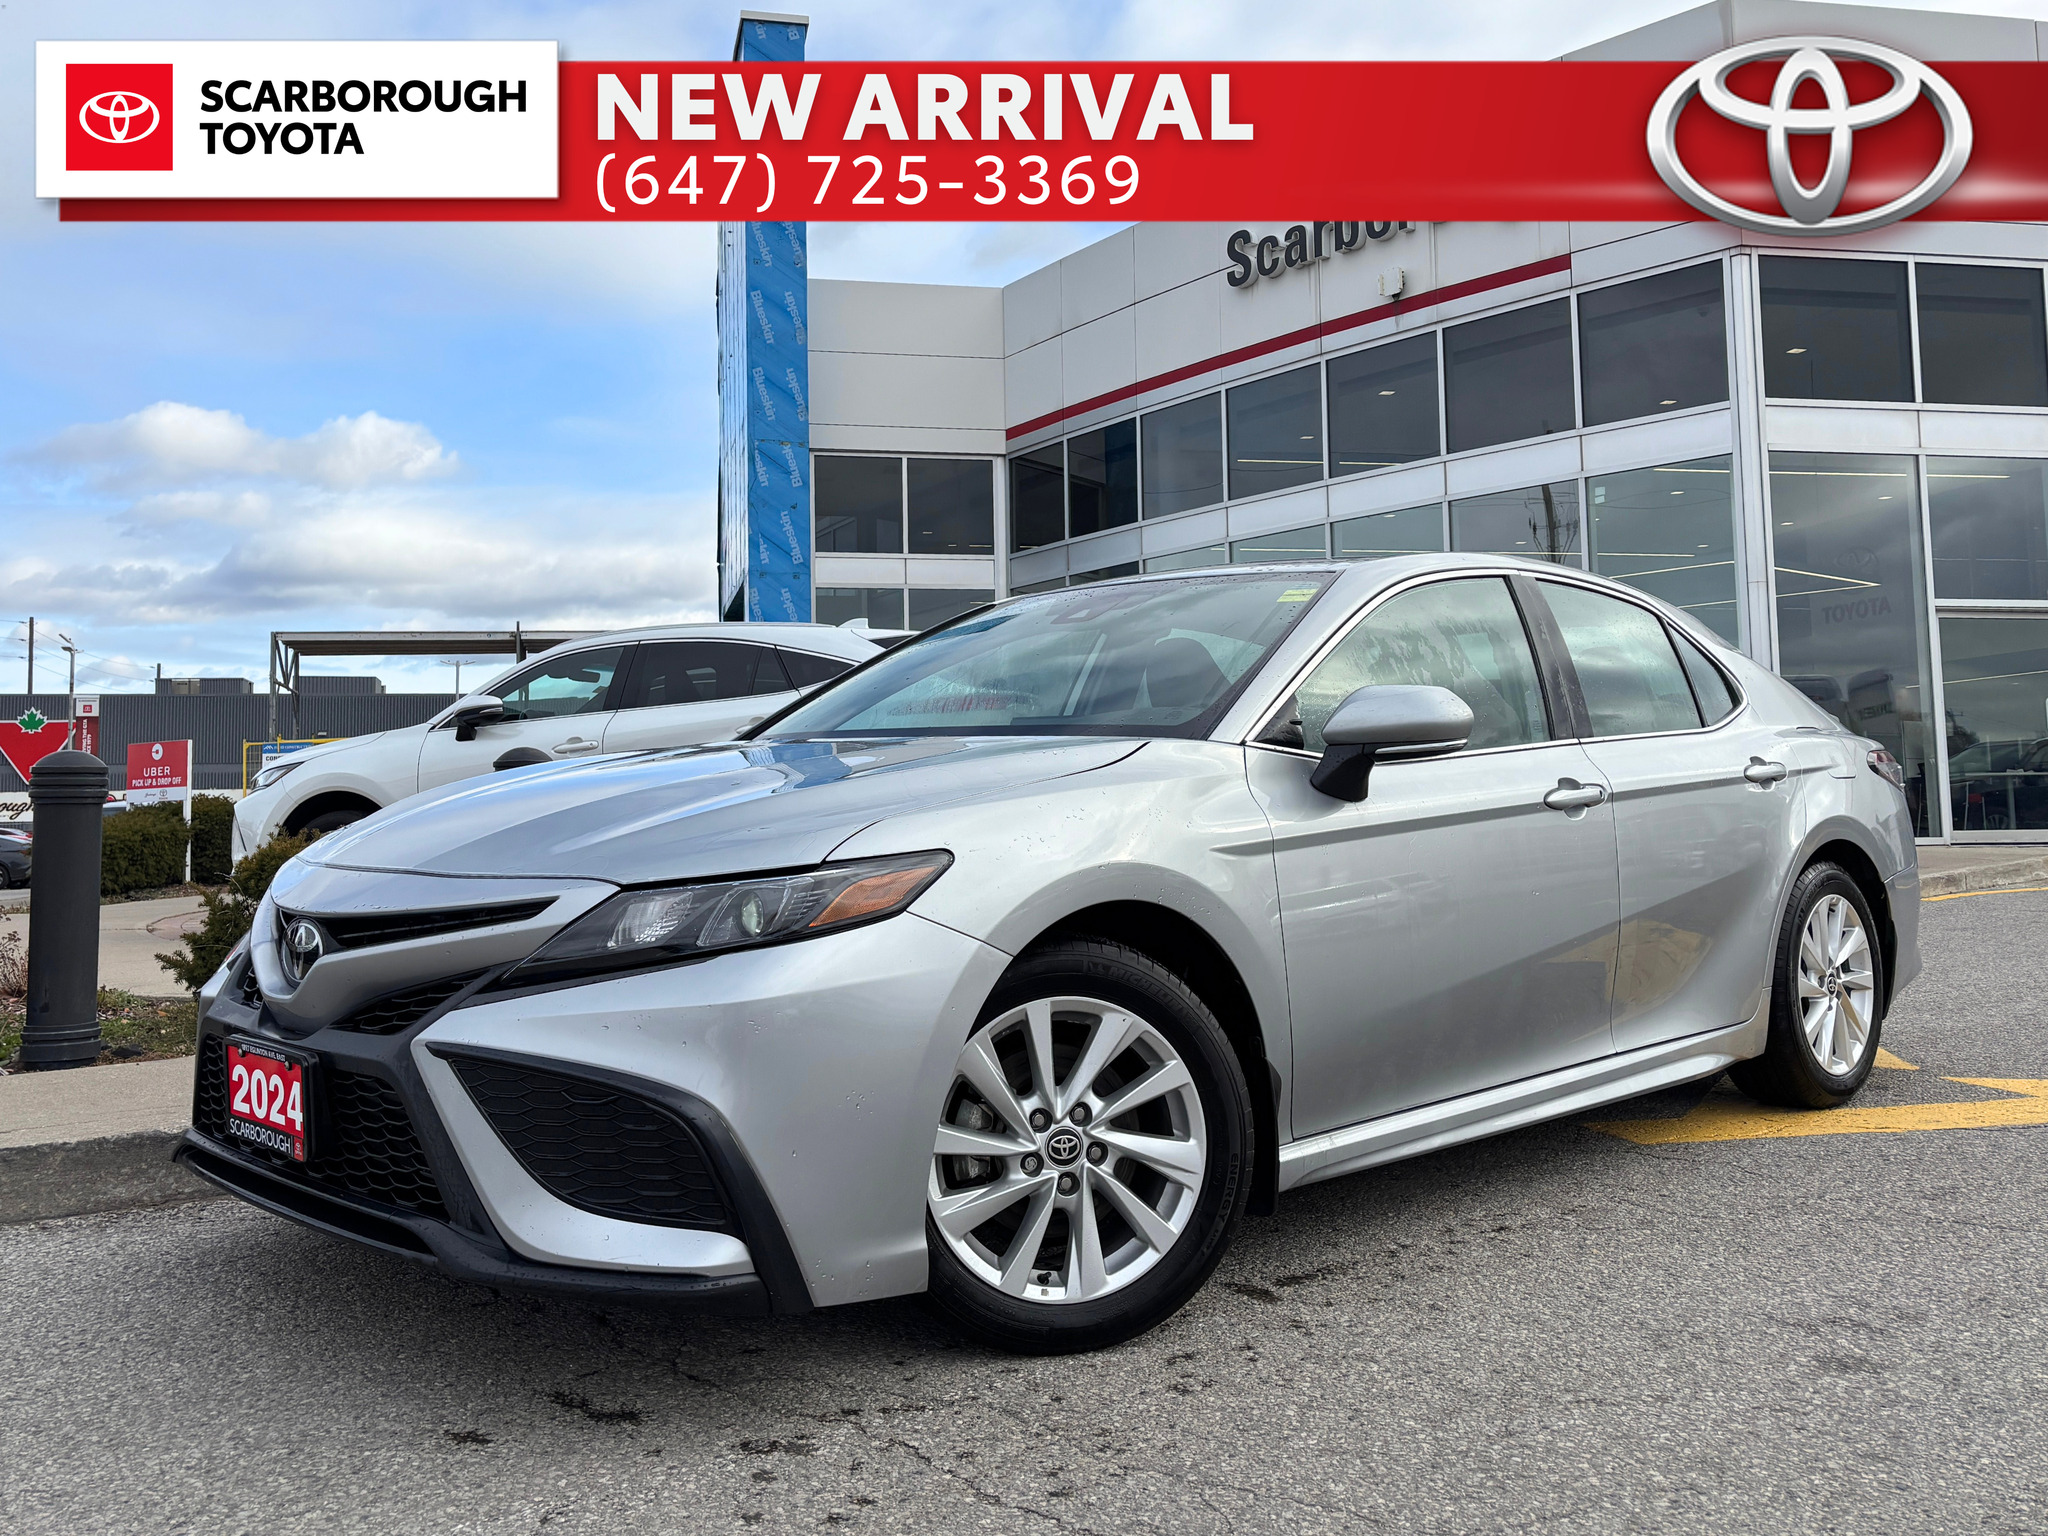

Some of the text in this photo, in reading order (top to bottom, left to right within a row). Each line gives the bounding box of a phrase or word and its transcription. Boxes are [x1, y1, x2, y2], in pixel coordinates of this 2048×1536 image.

[751, 221, 773, 267] lueskin
[750, 289, 775, 345] Blueskin
[752, 366, 776, 421] Blueskin
[786, 367, 808, 422] Blueskin
[780, 510, 804, 565] Blueskin
[132, 779, 144, 787] PICK
[152, 778, 157, 786] &
[157, 777, 172, 786] DROP
[172, 776, 182, 785] OFF
[143, 766, 171, 777] UBER
[232, 1064, 304, 1132] 2024
[229, 1118, 291, 1154] SCARBOROUGH
[1217, 1153, 1239, 1224] ENERGY
